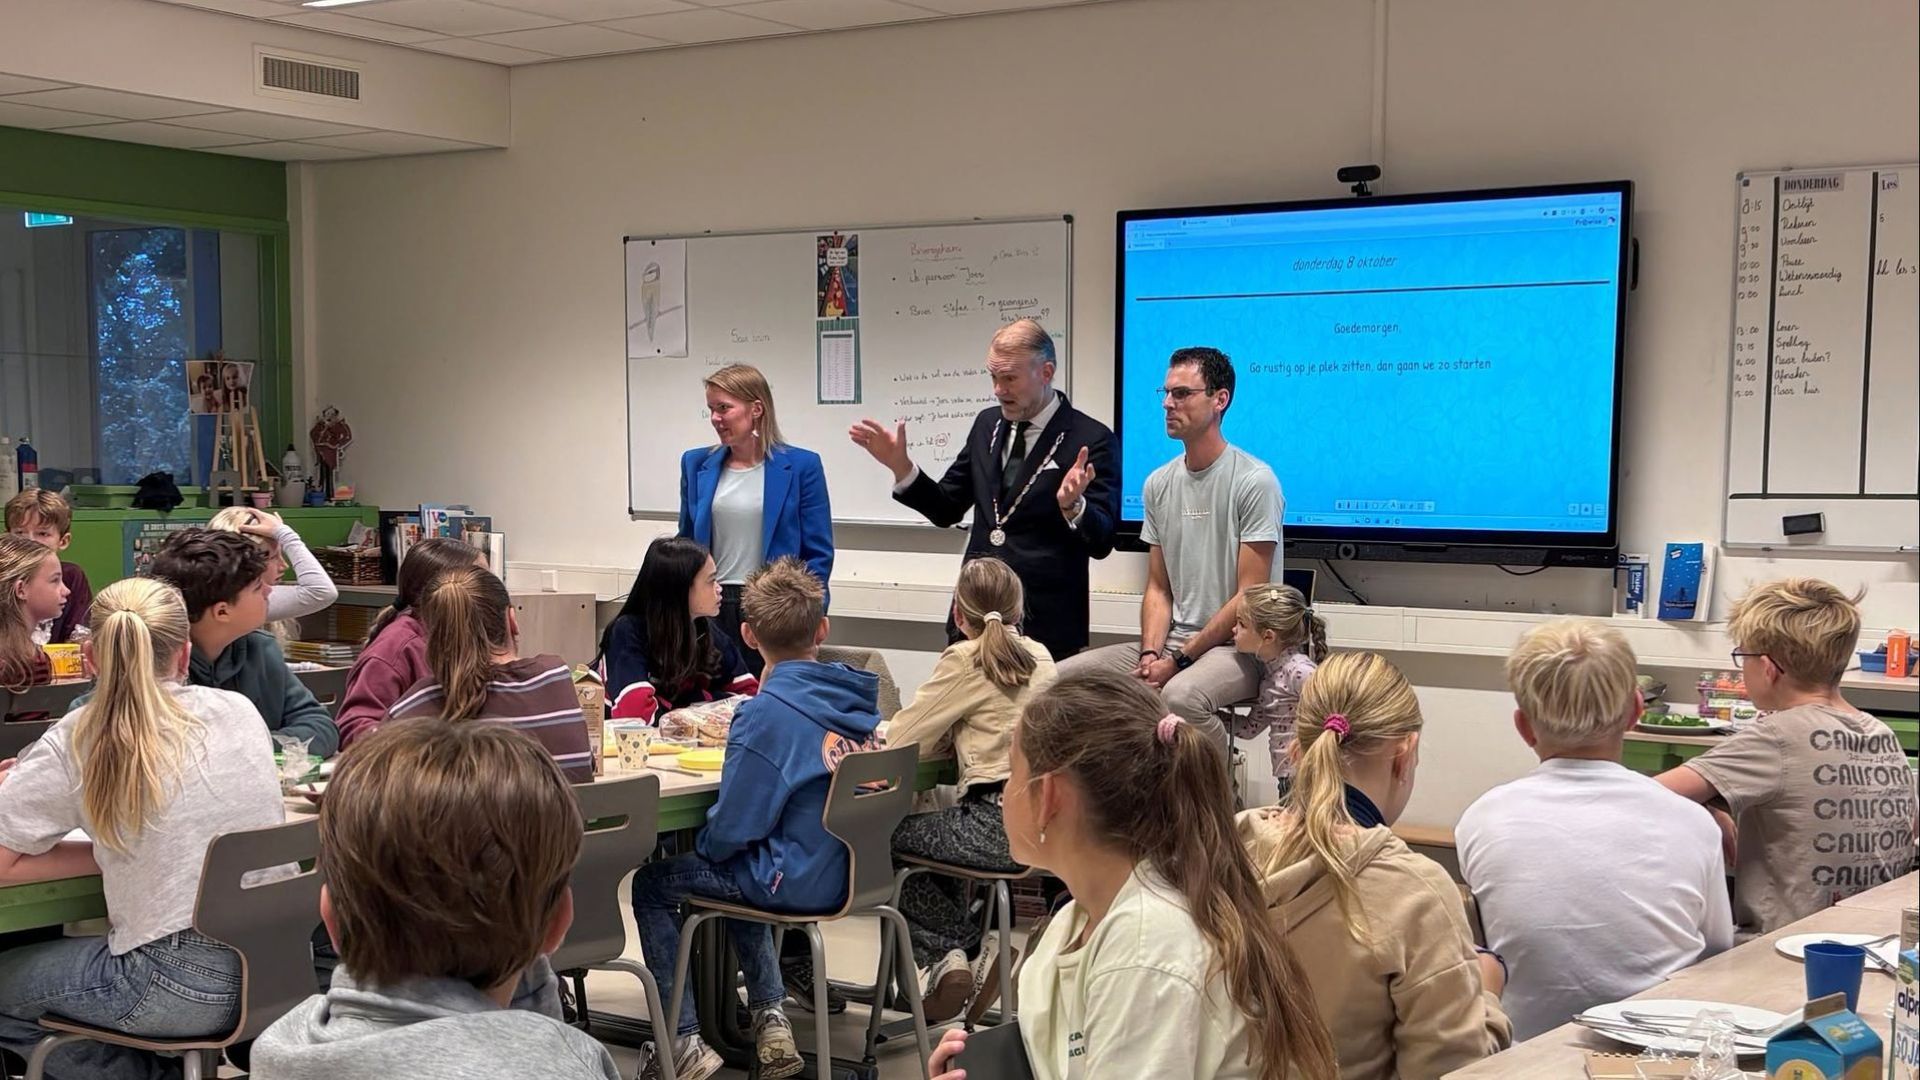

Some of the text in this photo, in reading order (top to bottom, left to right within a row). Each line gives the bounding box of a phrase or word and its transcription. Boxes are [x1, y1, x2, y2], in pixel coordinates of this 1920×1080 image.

[1783, 177, 1840, 191] DONDERDAG
[1881, 179, 1898, 191] Les
[1742, 198, 1762, 214] 8:15
[1292, 255, 1398, 273] donderdag 8 oktober
[1263, 361, 1292, 376] rustig
[1294, 362, 1305, 375] op
[1307, 361, 1316, 376] je
[1319, 360, 1339, 375] plek
[1377, 360, 1393, 372] dan
[1397, 361, 1420, 375] gaan
[1423, 360, 1435, 371] we
[1438, 361, 1450, 371] zo
[1453, 358, 1492, 370] starten
[1898, 986, 1919, 1018] alpr
